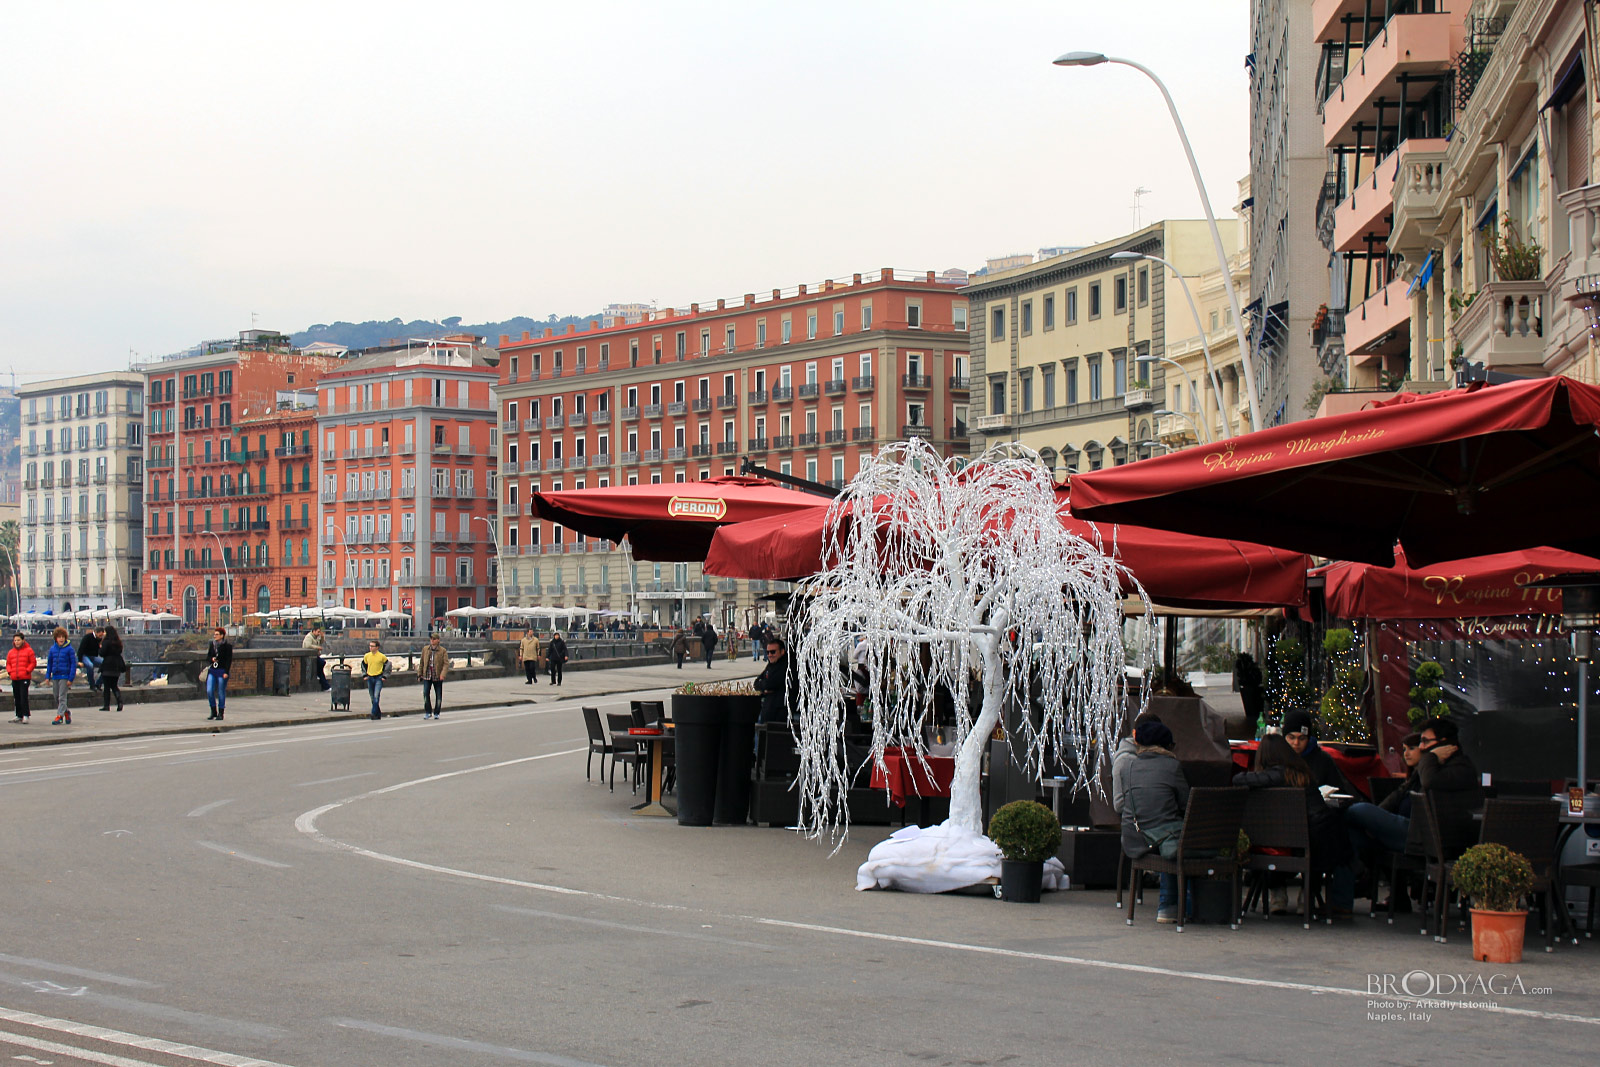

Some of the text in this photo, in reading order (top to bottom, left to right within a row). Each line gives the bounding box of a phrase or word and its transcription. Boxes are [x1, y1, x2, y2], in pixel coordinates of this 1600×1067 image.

[1203, 429, 1388, 472] Regina Margherita
[674, 502, 721, 514] PERONI
[1422, 575, 1514, 605] Regina
[1455, 616, 1529, 636] Regina
[1571, 799, 1583, 807] 102
